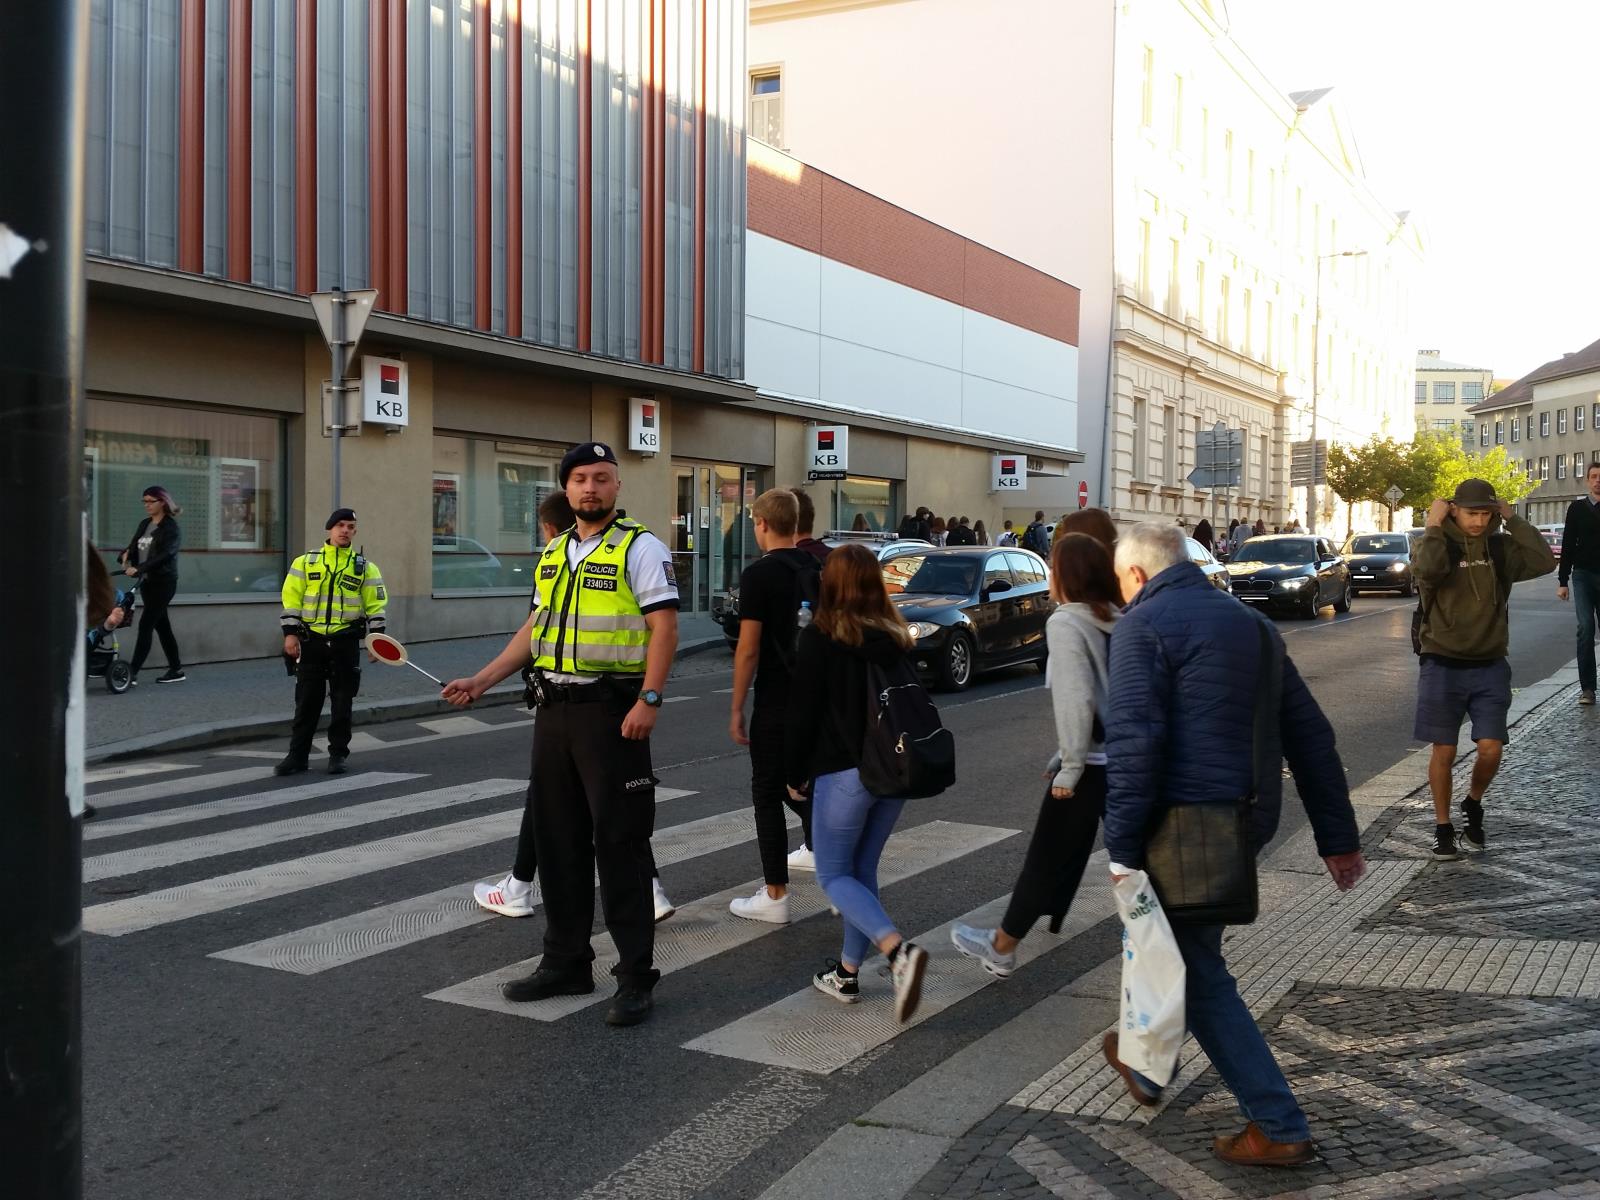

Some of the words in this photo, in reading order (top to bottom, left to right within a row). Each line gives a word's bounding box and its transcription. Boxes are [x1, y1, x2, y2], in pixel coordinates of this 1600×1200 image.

[376, 399, 403, 418] KB
[639, 432, 656, 446] KB
[814, 454, 839, 466] KB
[998, 478, 1019, 487] KB
[585, 563, 617, 575] POLICIE
[586, 578, 614, 590] 334053
